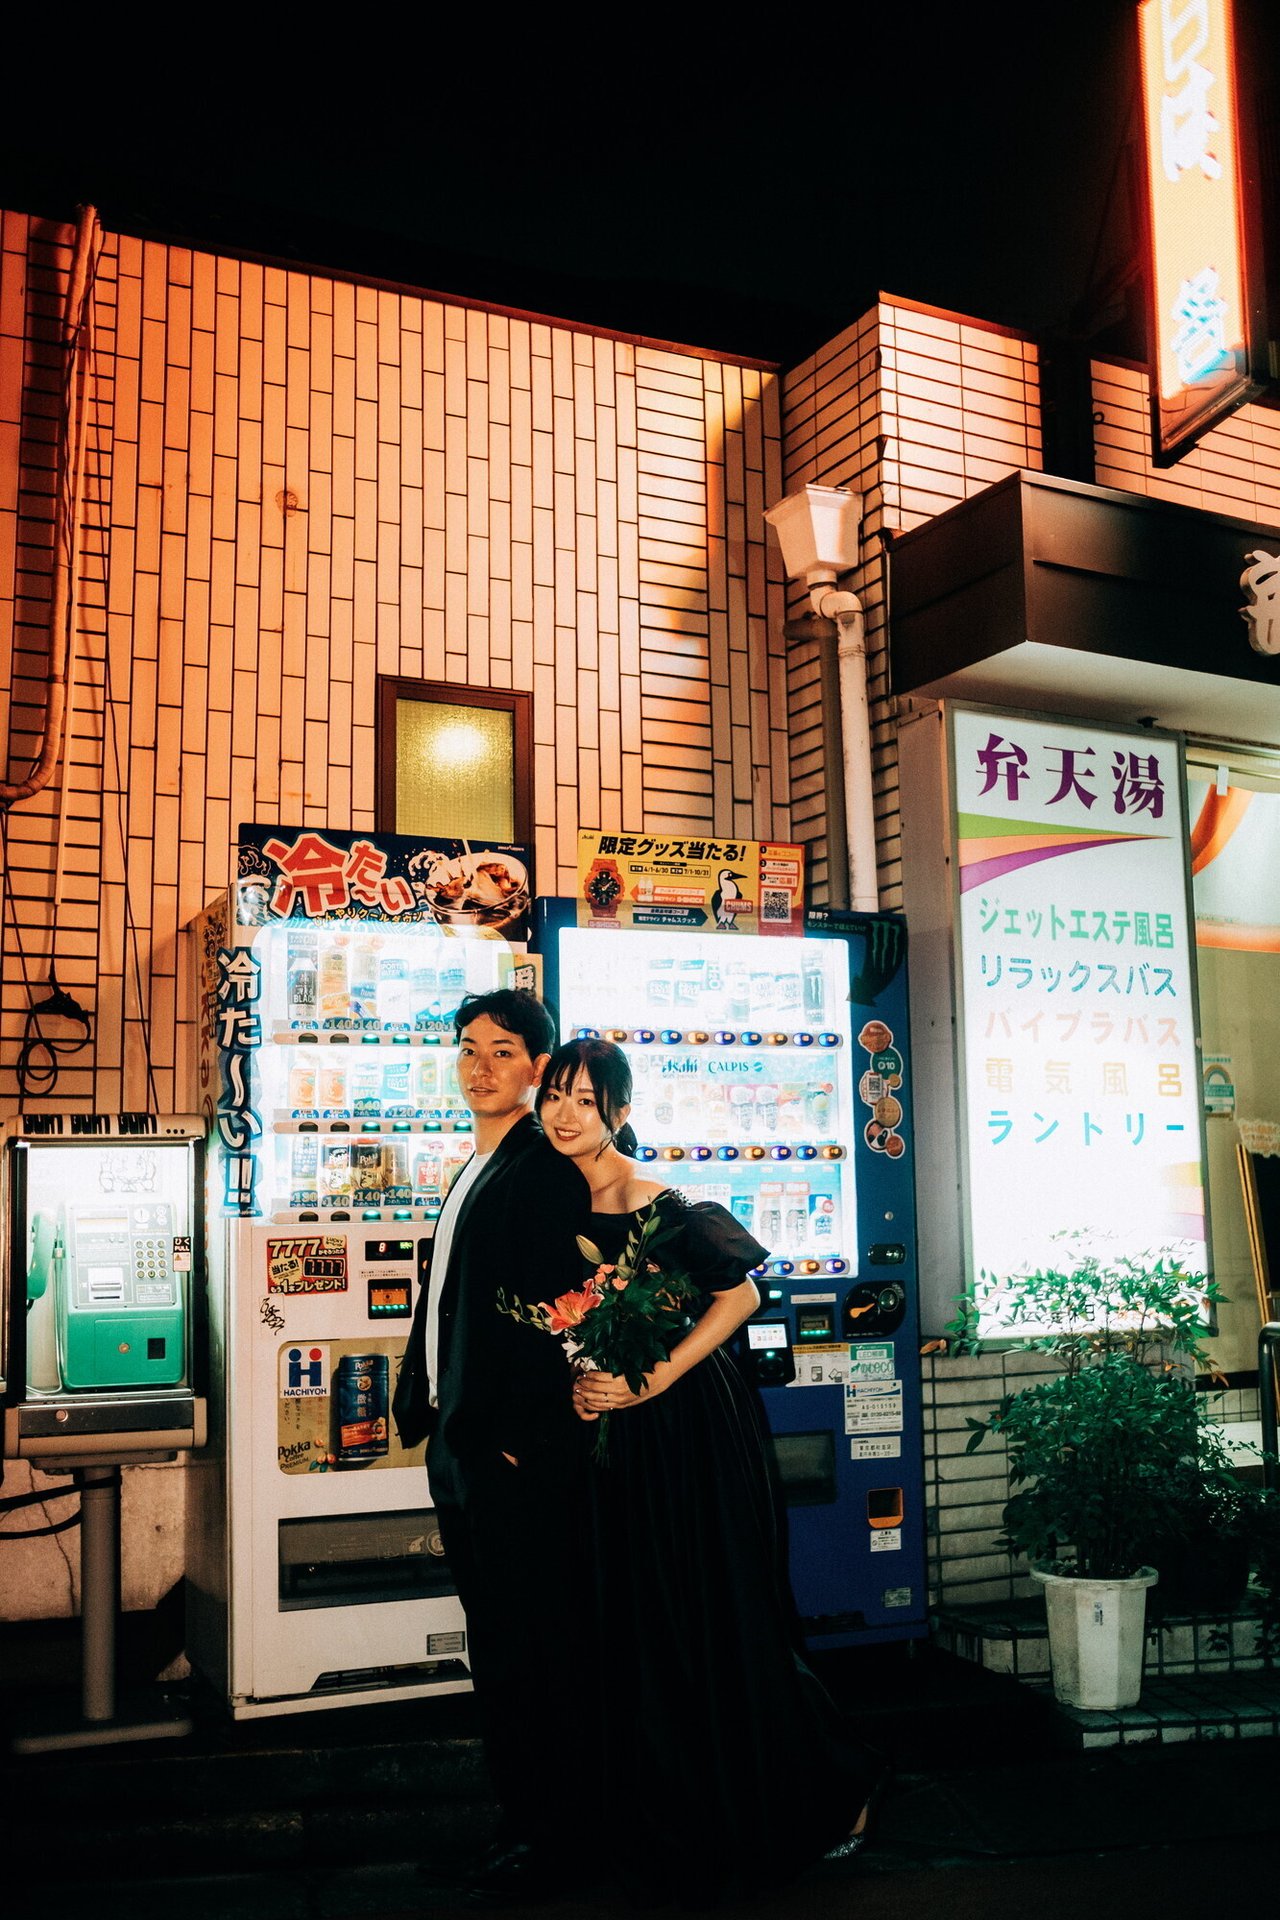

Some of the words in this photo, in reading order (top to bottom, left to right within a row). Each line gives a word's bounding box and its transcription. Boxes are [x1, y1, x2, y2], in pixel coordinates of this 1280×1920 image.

[975, 732, 1166, 820] 弁天湯
[597, 835, 747, 862] 限定グッズ当たる!
[684, 869, 709, 877] 7/1-10/31
[725, 900, 753, 912] CHUMS
[979, 898, 1175, 949] ジェットエステ風呂
[980, 954, 1178, 998] リラックスバス
[293, 994, 317, 1004] BLACK
[708, 1060, 750, 1075] CALPIS
[984, 1056, 1184, 1097] 電気風呂
[268, 1238, 321, 1258] 7777
[272, 1258, 300, 1276] 当たる!
[270, 1278, 346, 1294] もう1本プレゼント!
[283, 1387, 328, 1397] HACHIYOH
[278, 1441, 311, 1460] Pokka
[285, 1452, 305, 1463] Coffee
[279, 1457, 309, 1470] PREMIUM
